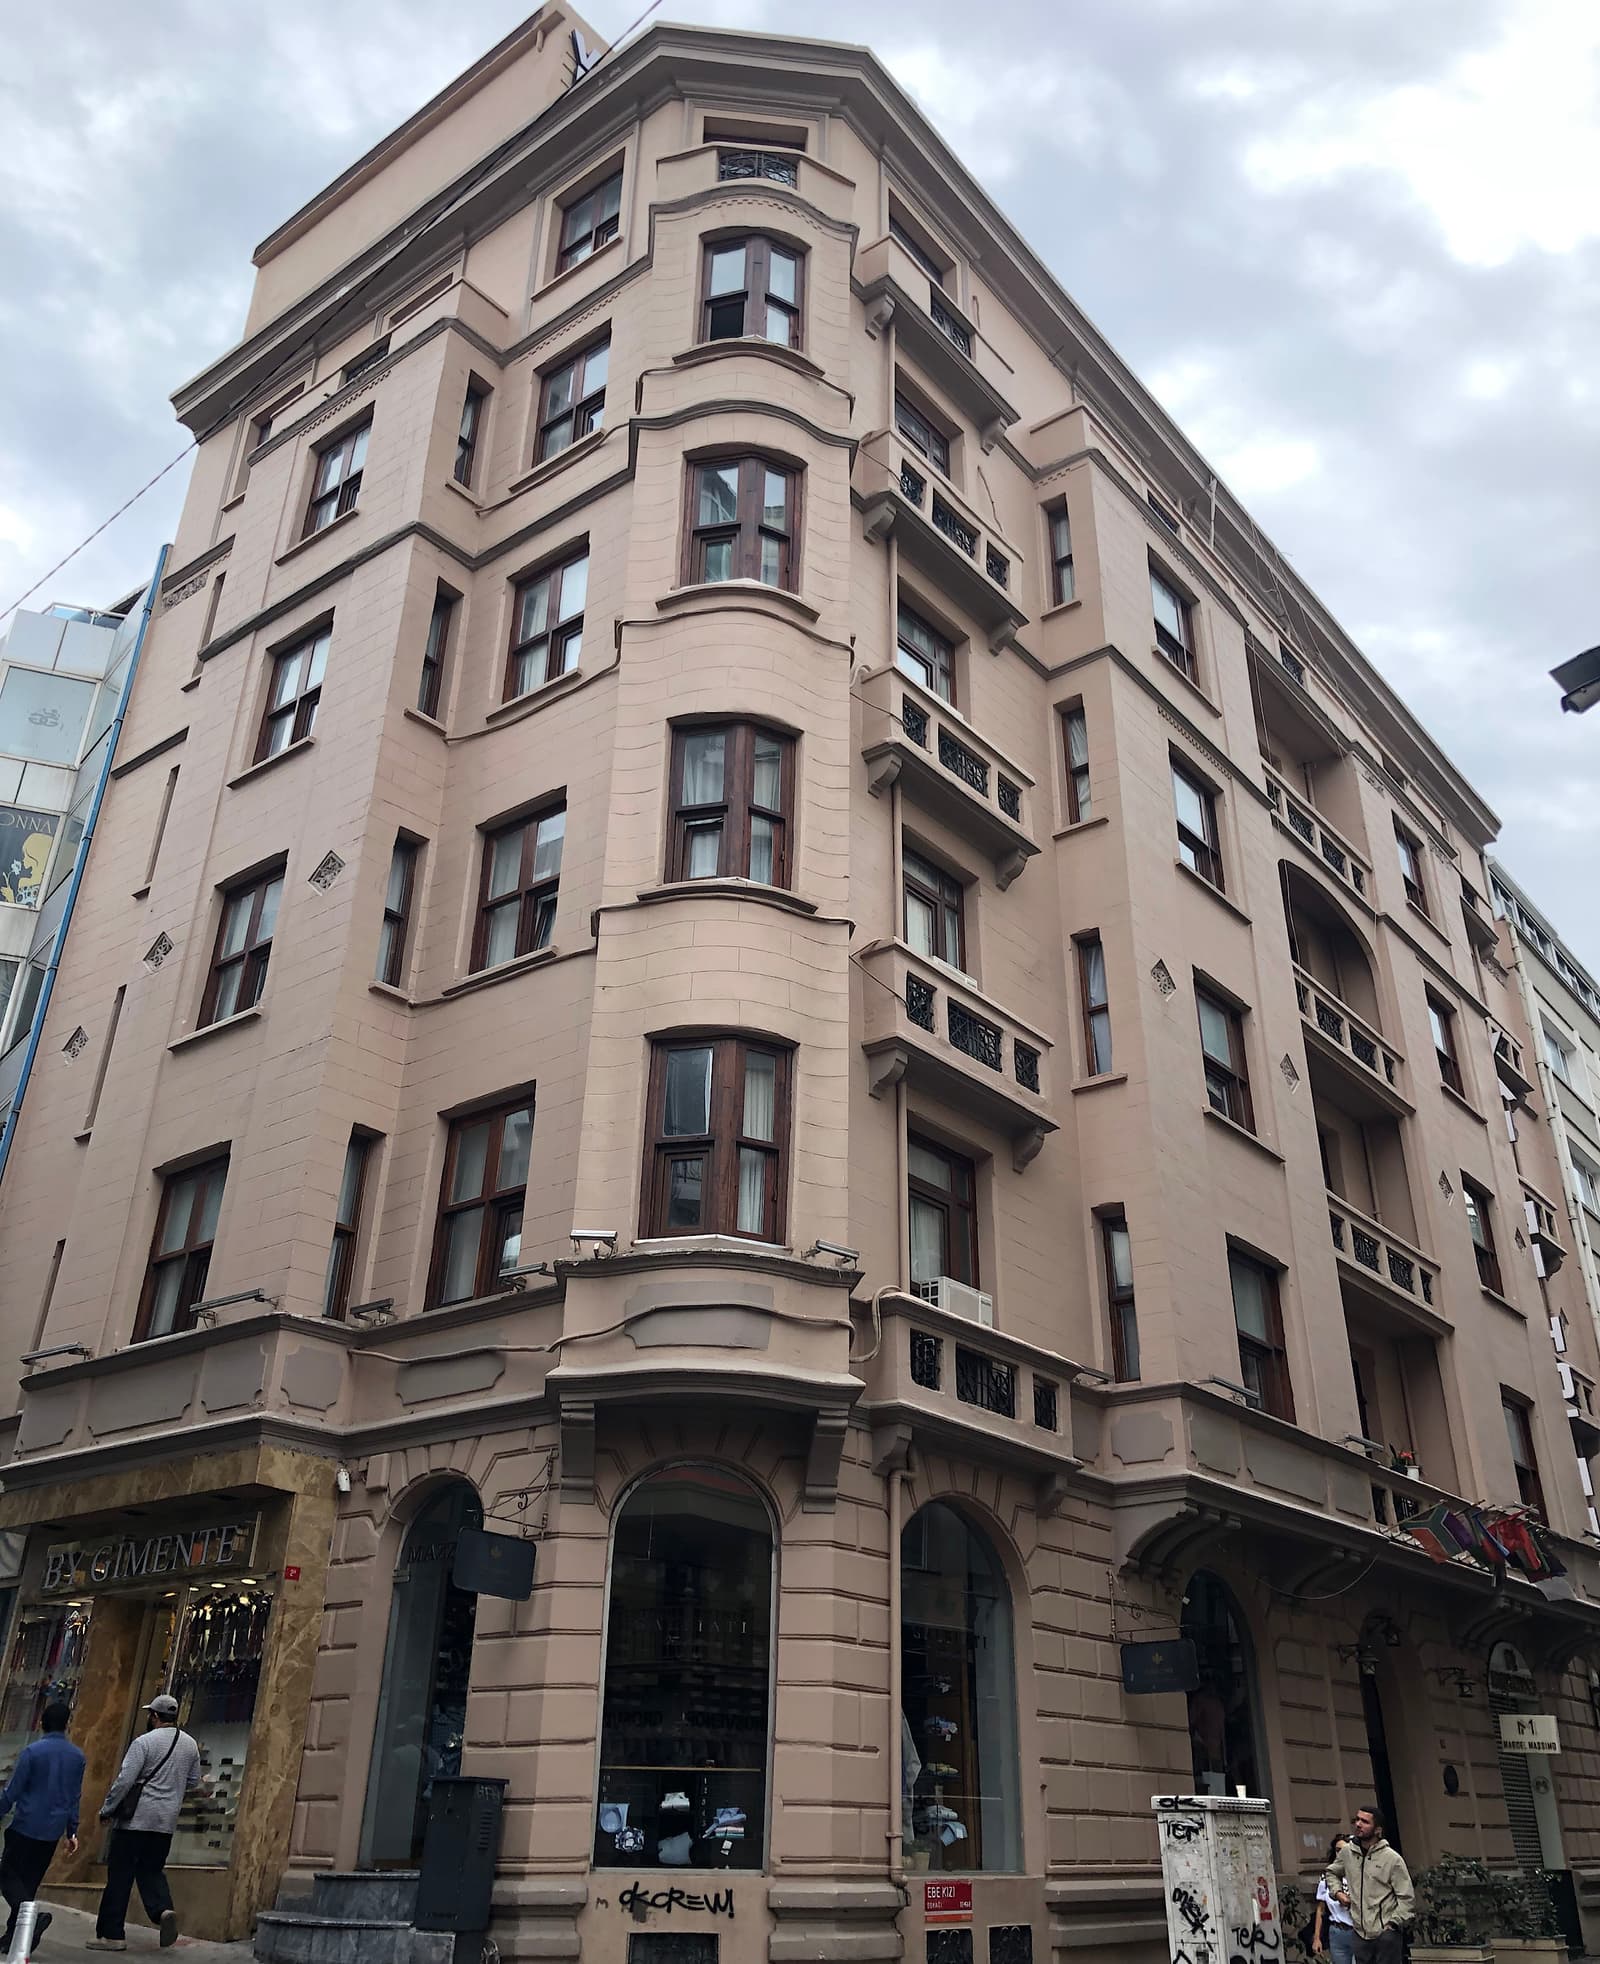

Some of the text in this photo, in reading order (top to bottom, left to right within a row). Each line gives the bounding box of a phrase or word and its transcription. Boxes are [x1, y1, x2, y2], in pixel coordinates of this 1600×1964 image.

[42, 1550, 85, 1589] BY
[927, 1885, 956, 1898] EBE KIZI
